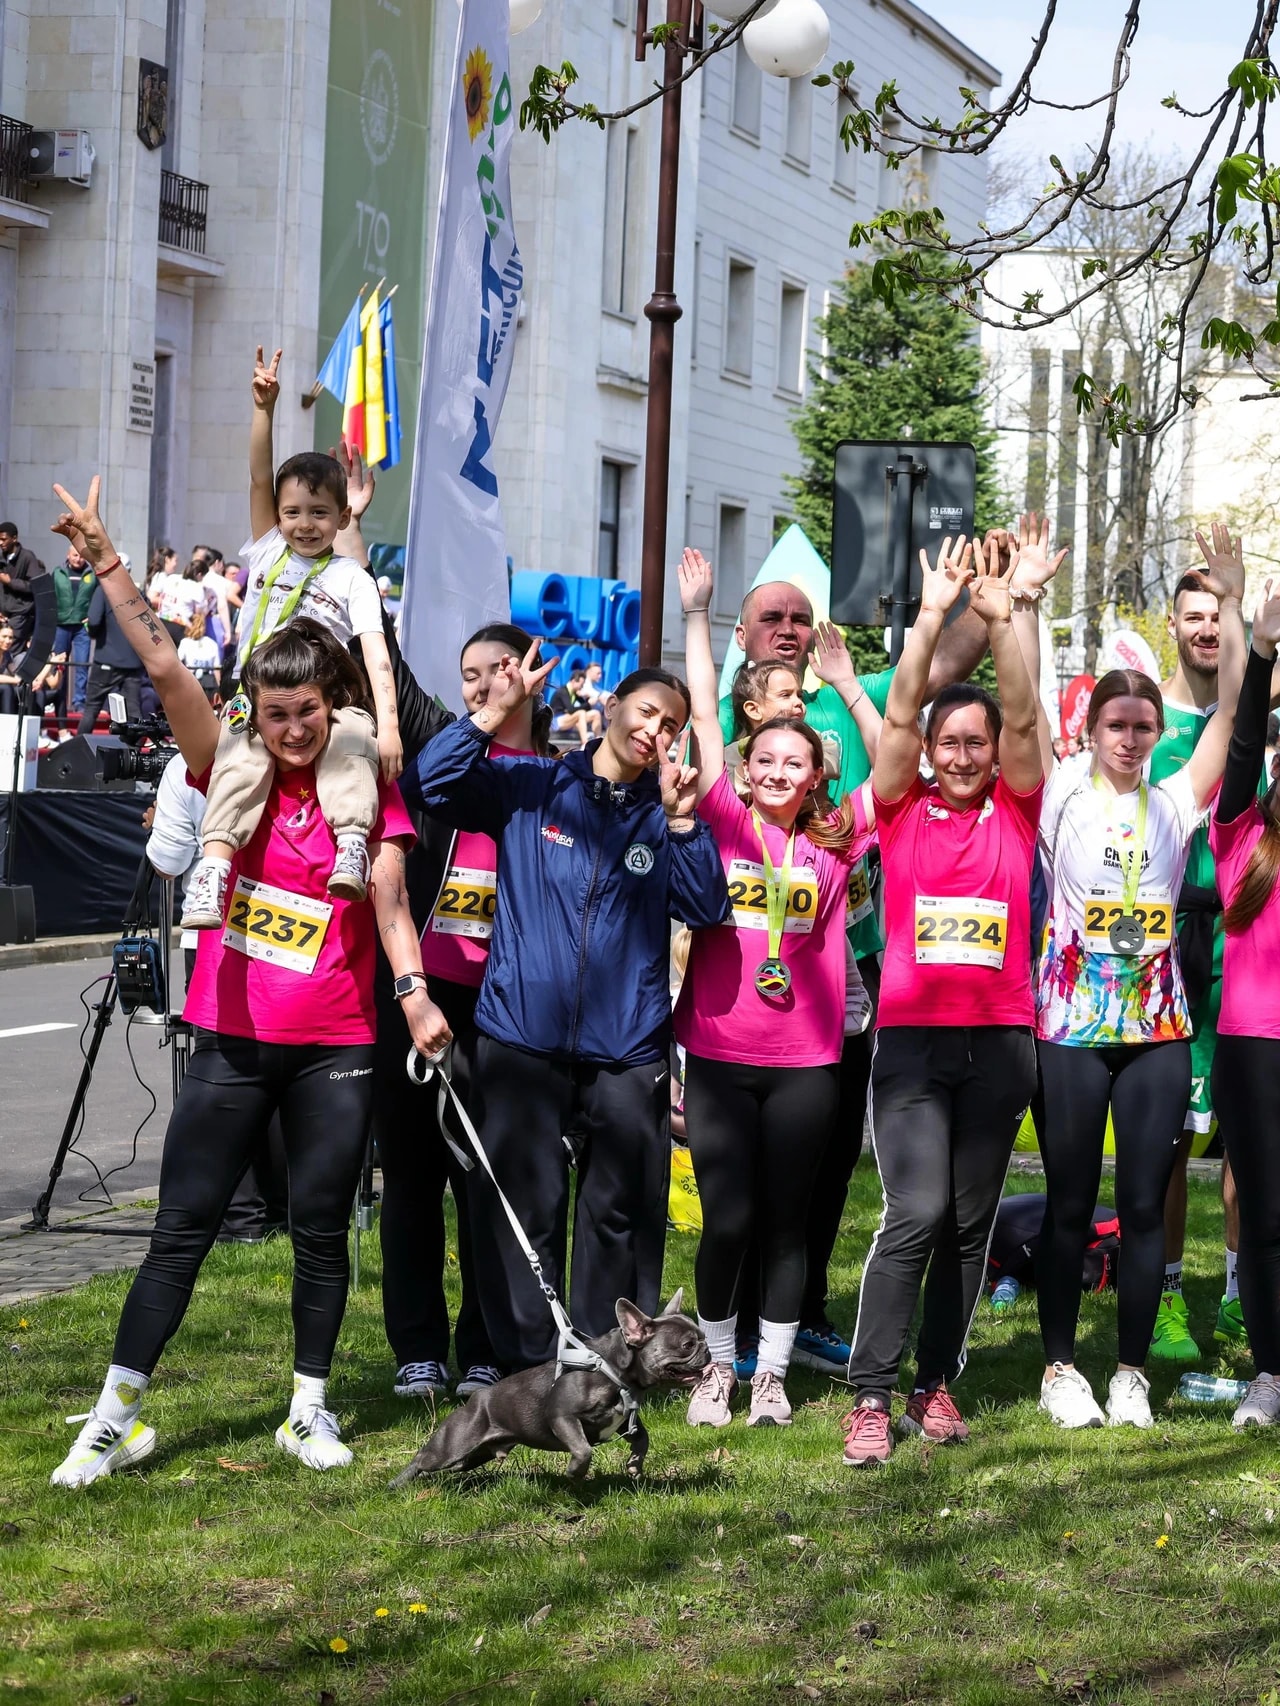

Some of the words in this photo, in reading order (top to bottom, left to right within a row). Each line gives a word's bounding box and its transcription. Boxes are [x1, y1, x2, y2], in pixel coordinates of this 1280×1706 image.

[541, 827, 575, 845] SAMURAI
[440, 888, 497, 918] 220
[729, 880, 813, 913] 220
[230, 900, 319, 948] 2237
[917, 916, 1002, 946] 2224
